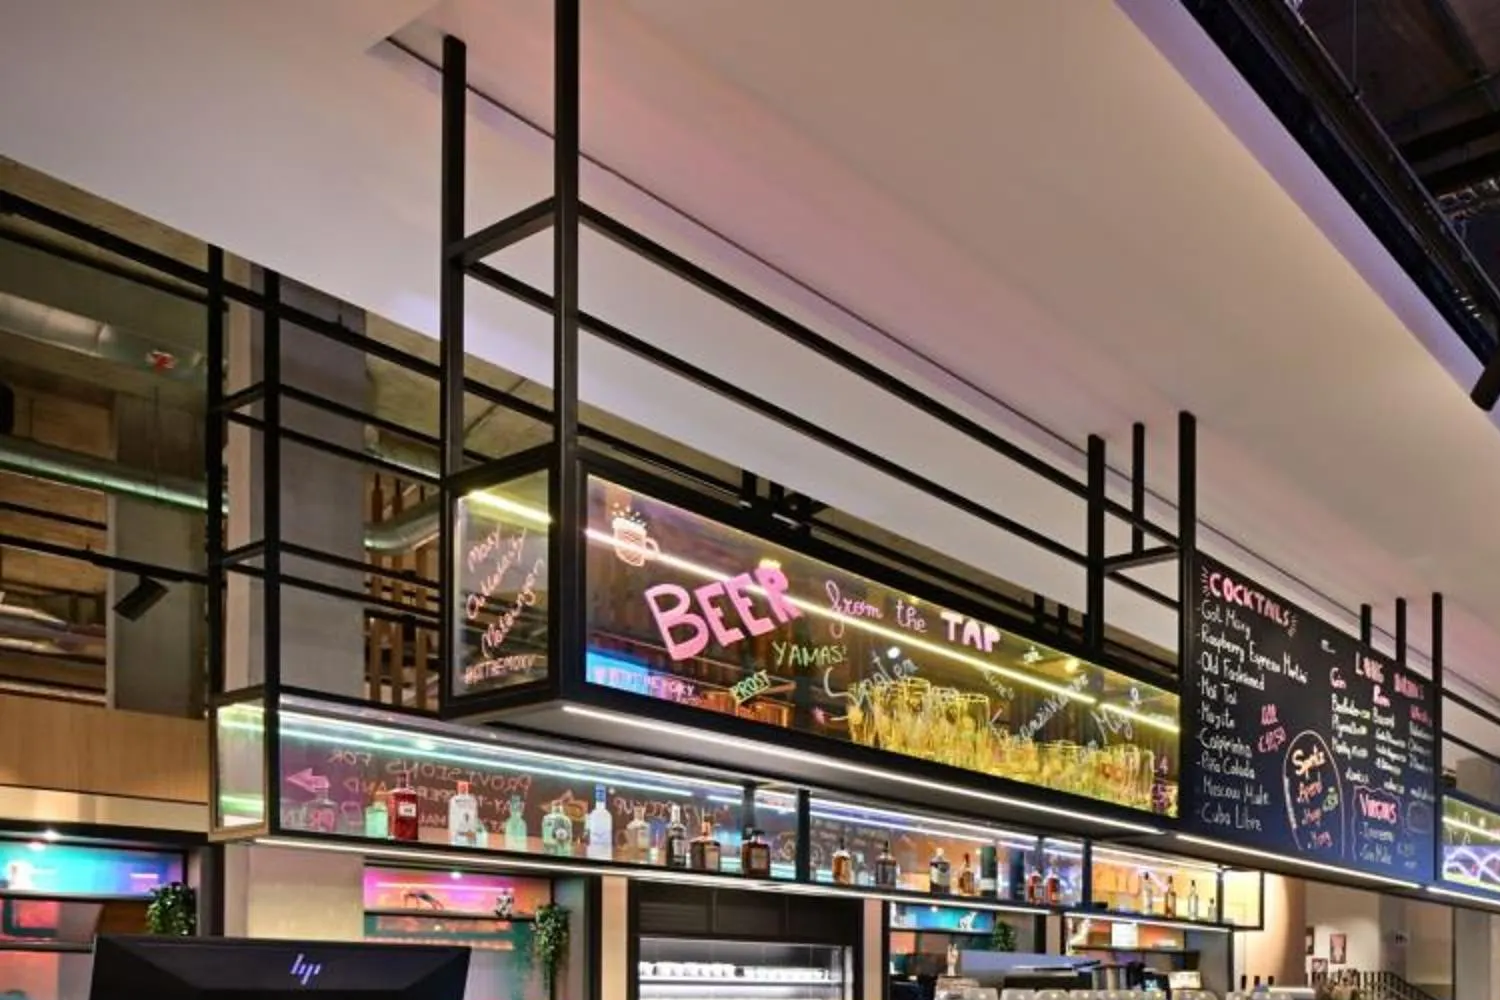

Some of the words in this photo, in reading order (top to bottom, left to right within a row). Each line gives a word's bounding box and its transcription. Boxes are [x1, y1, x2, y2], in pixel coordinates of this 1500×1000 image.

[645, 562, 802, 661] BEER
[826, 580, 882, 637] from
[896, 600, 925, 633] the
[940, 611, 1000, 652] TAP
[1209, 573, 1289, 627] COCKTAILS
[1201, 650, 1219, 675] Old
[1201, 802, 1231, 825] Cuba
[289, 953, 321, 985] hp
